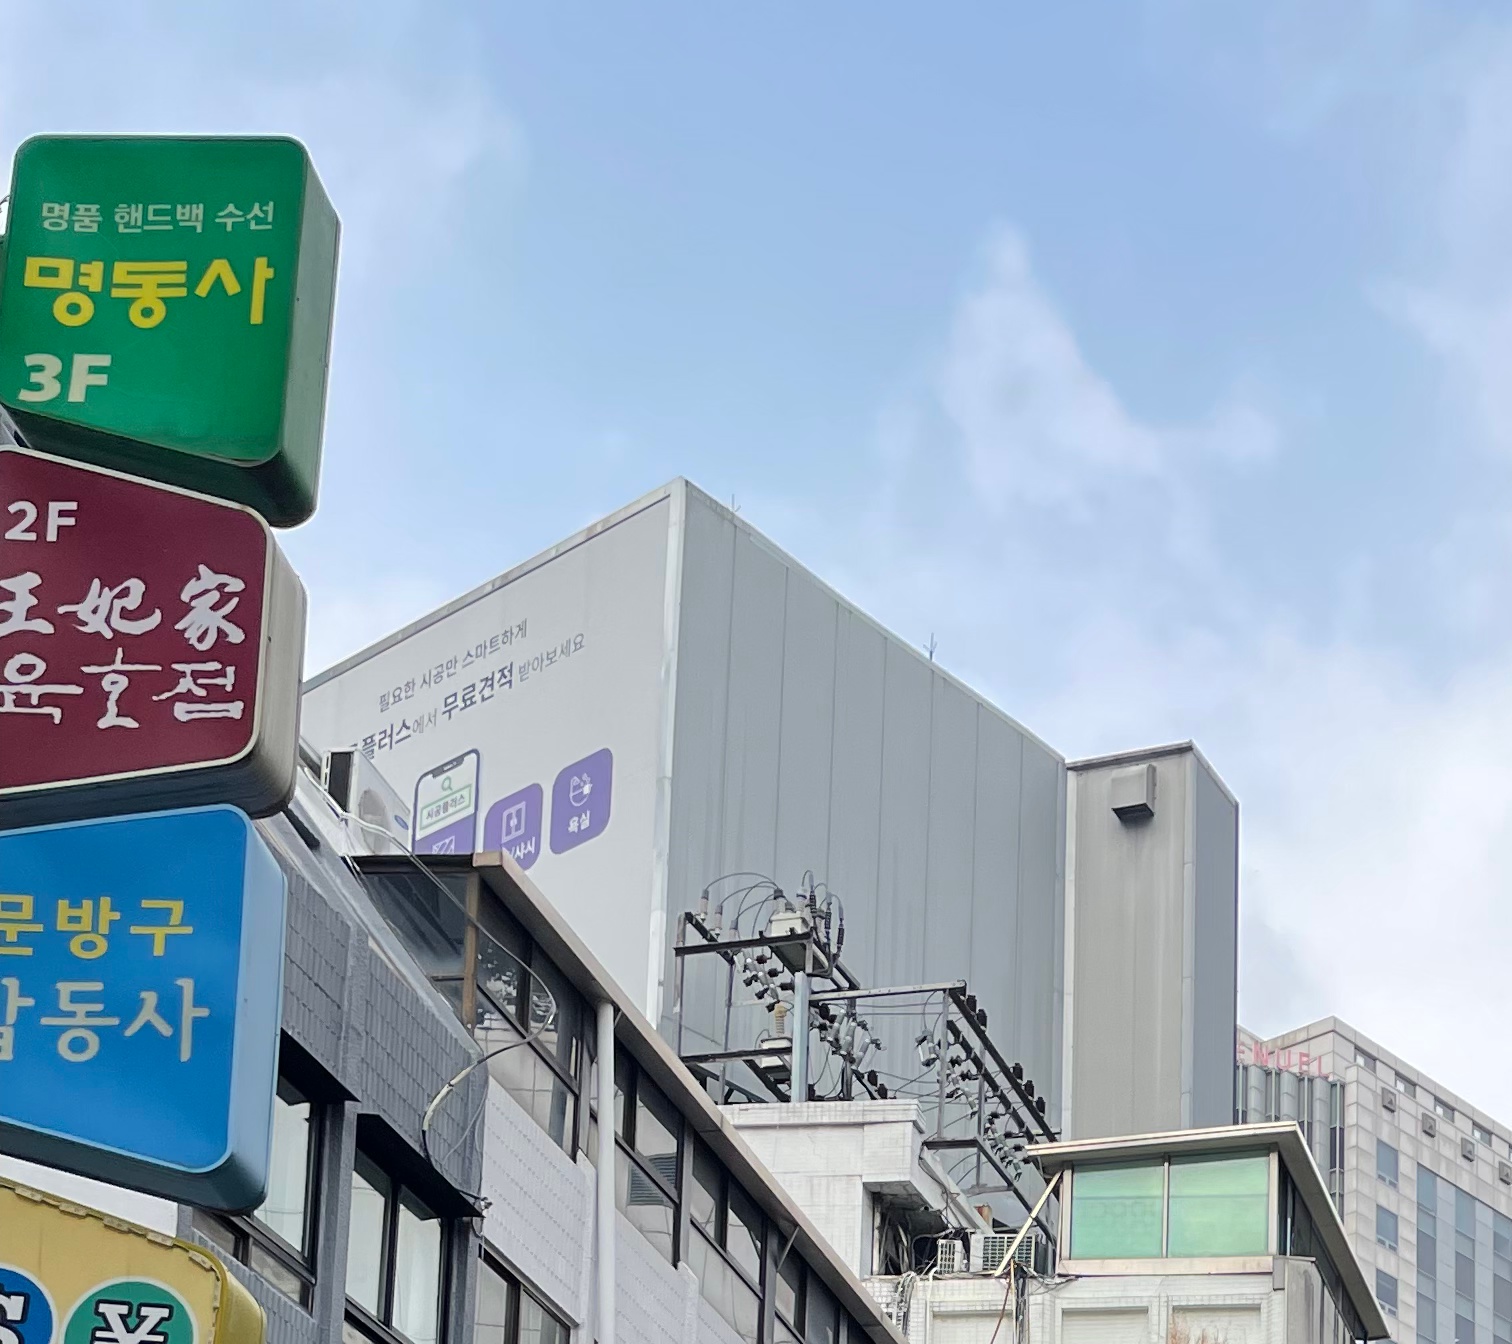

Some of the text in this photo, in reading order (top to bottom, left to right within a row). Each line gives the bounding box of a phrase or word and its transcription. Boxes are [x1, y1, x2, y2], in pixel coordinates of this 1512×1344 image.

[41, 202, 275, 234] 명품 핸드백 수선
[24, 256, 274, 329] 명동사
[18, 353, 111, 403] 3F
[4, 500, 78, 542] 2F
[0, 563, 245, 651] 王妃家
[350, 633, 585, 760] 플러스에서 무료견적 받아보세요
[379, 619, 528, 713] 필요한 시공만 스마트하게
[568, 809, 590, 833] 욕실
